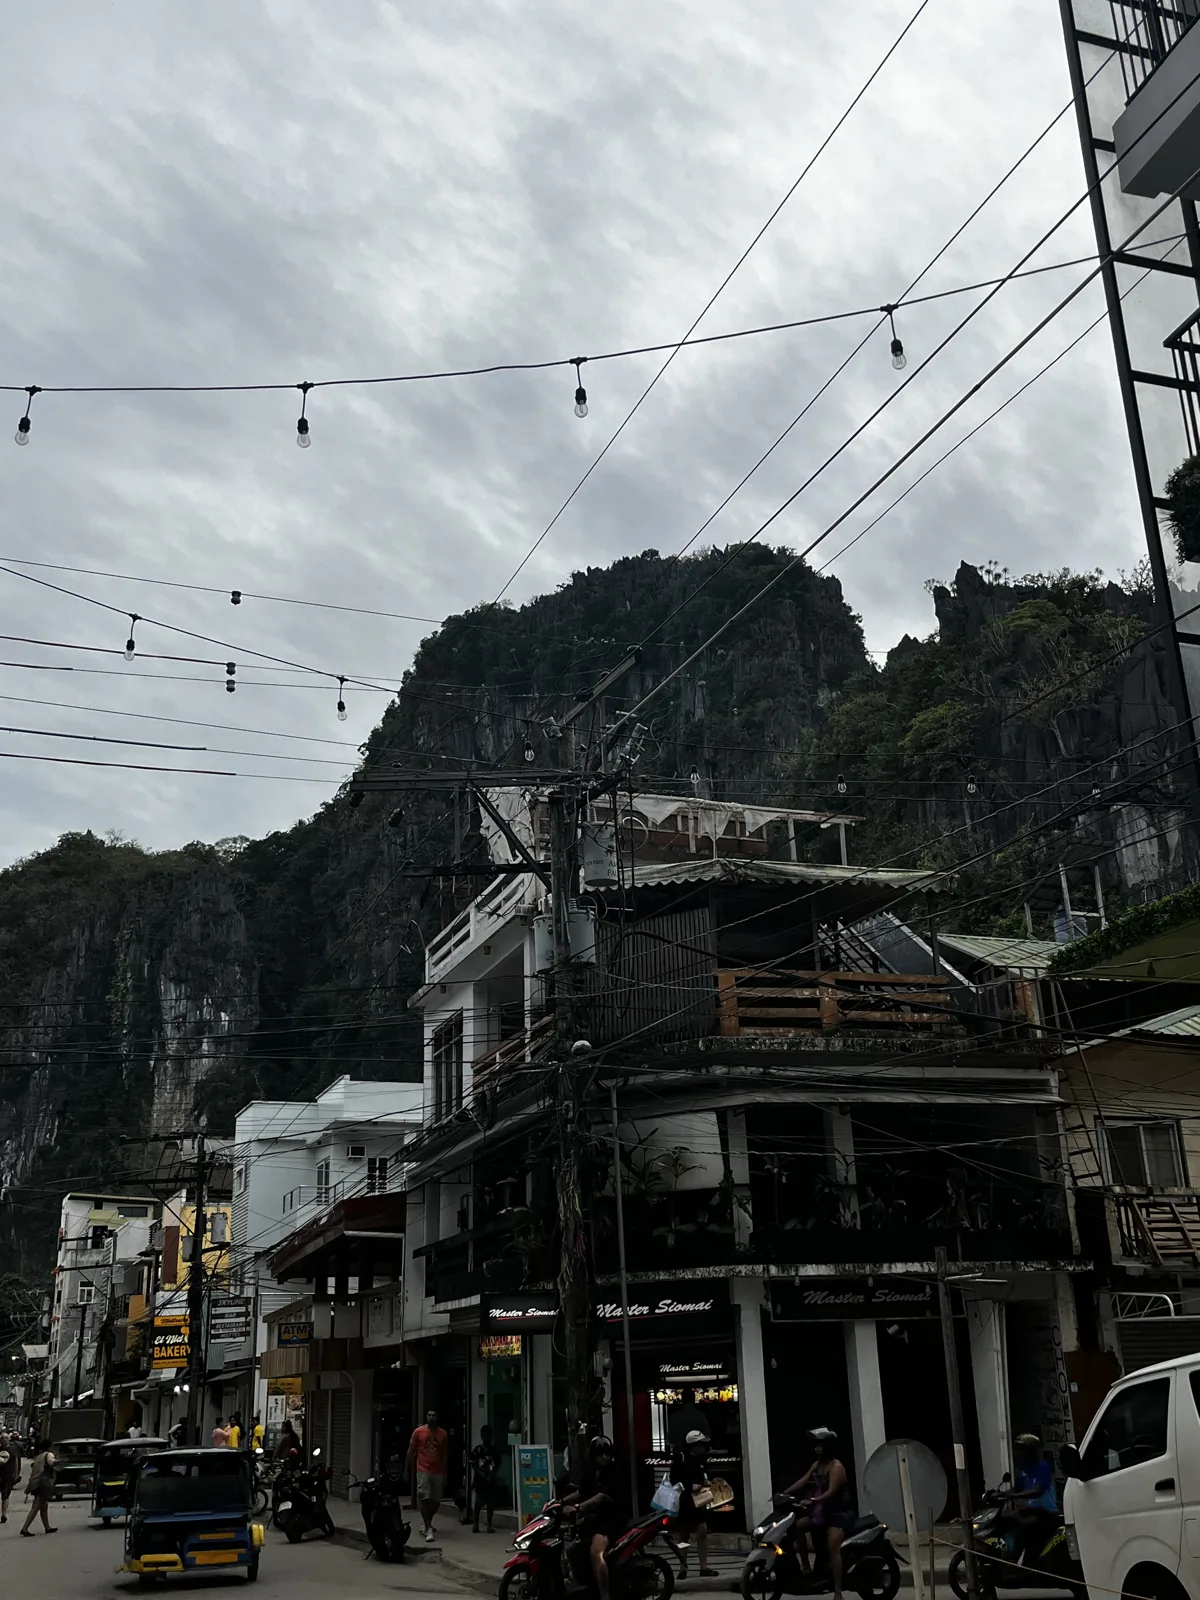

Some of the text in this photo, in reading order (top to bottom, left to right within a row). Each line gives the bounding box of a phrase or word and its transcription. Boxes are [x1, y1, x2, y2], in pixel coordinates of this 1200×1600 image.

[802, 1288, 933, 1305] Master Siomai
[217, 1298, 245, 1306] SKYLINE
[488, 1308, 523, 1318] Master
[596, 1299, 714, 1318] Mater Siomai
[283, 1325, 306, 1334] ATM
[154, 1335, 165, 1345] El
[153, 1344, 191, 1358] BAKERY
[659, 1362, 723, 1373] Master Siomai
[706, 1456, 742, 1464] iomai
